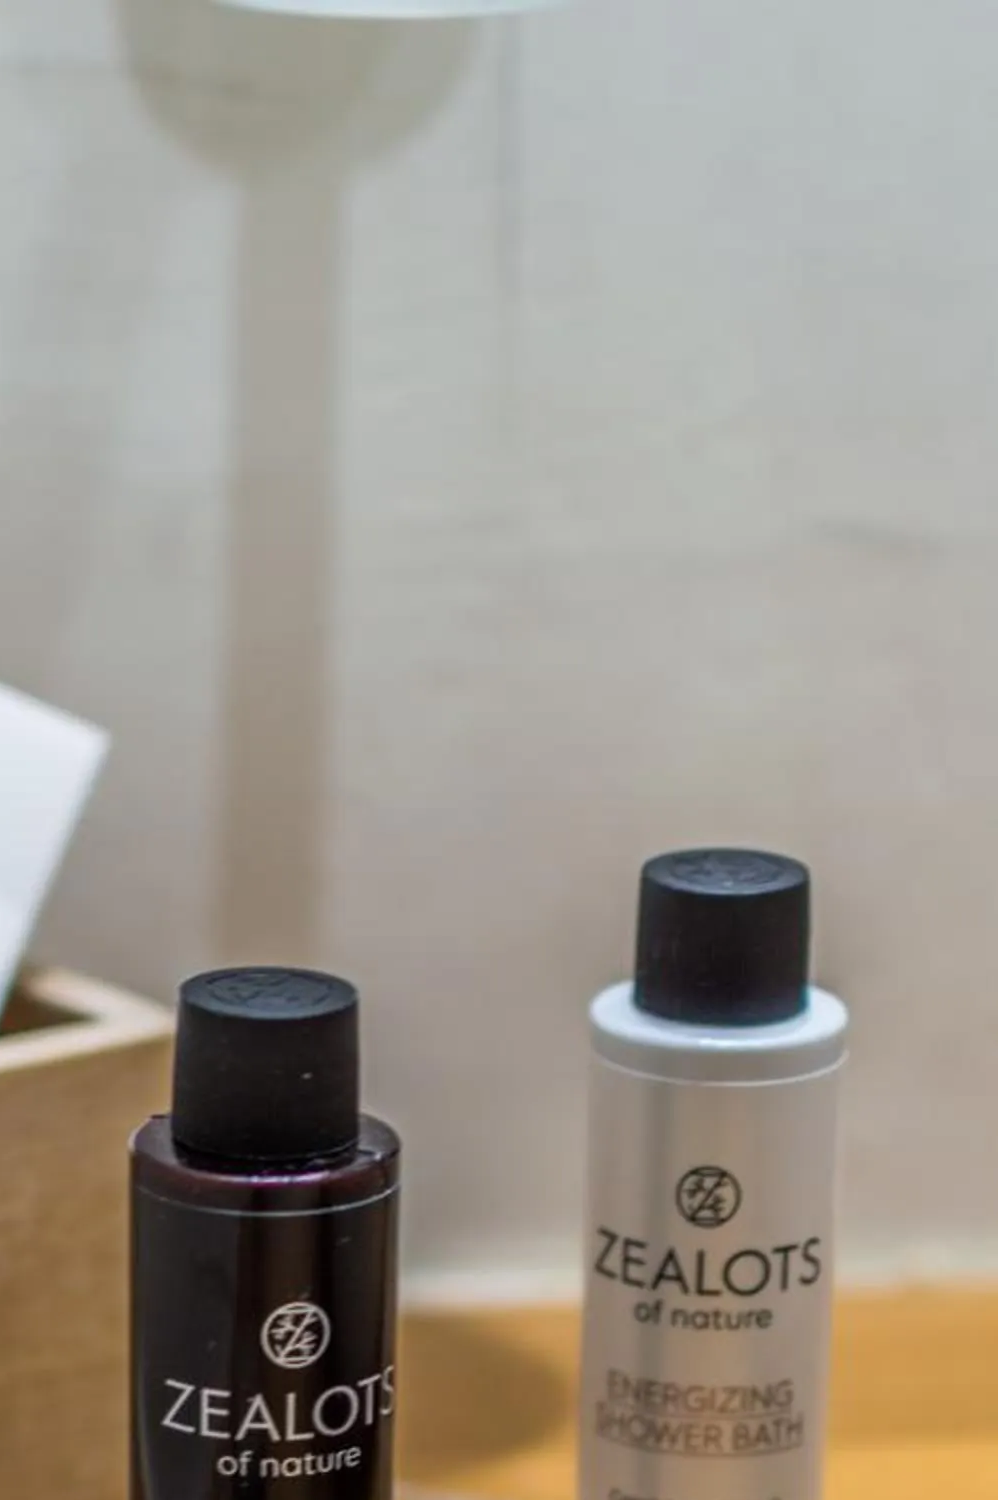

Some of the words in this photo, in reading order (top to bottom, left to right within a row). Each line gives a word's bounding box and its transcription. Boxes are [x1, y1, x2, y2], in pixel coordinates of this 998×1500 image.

[593, 1225, 822, 1297] ZEALOTS
[633, 1299, 664, 1324] of
[670, 1307, 774, 1331] nature
[161, 1365, 394, 1442] ZEALOTS
[606, 1367, 795, 1414] ENERGIZING
[731, 1410, 805, 1451] BATH
[216, 1450, 254, 1477] of
[259, 1446, 362, 1478] nature
